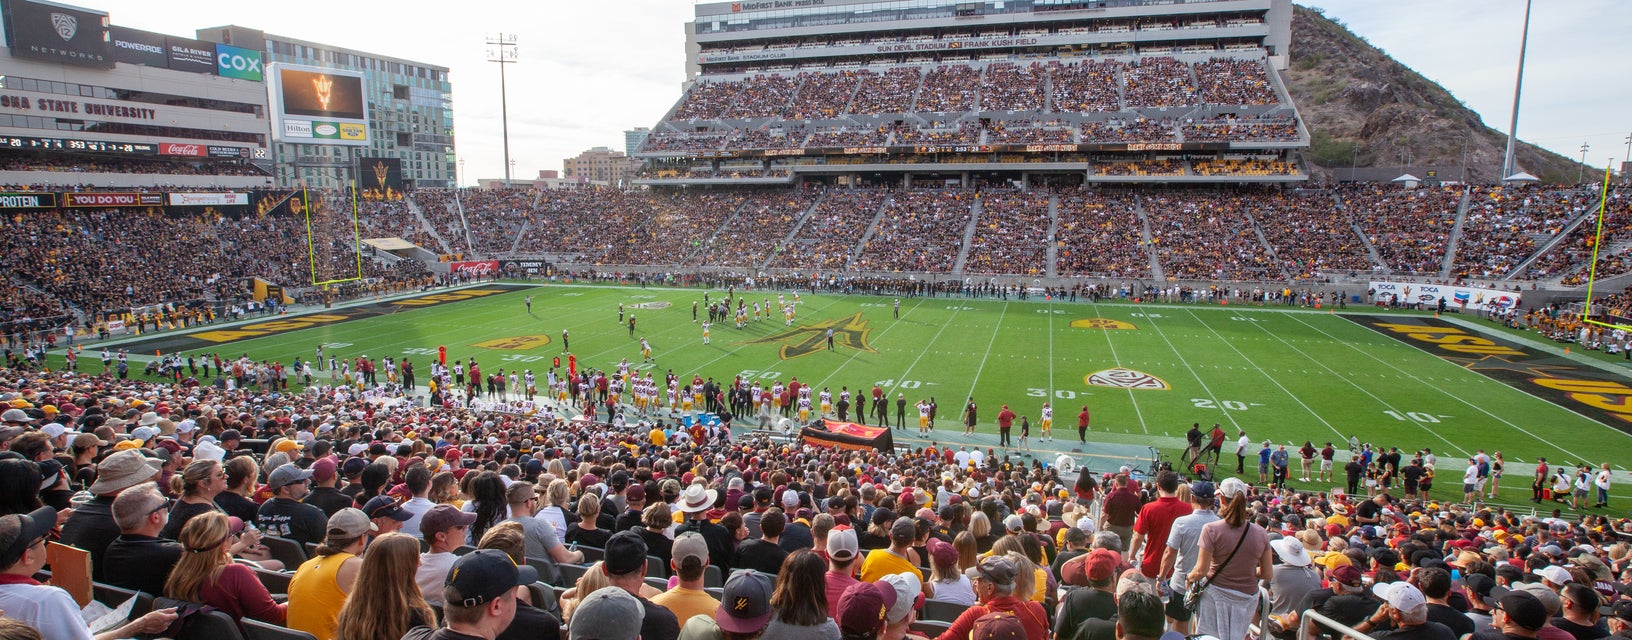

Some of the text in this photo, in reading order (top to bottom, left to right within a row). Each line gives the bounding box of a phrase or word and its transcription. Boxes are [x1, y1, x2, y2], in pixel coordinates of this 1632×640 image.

[774, 0, 793, 8] BANK
[114, 40, 163, 55] POWERADE
[916, 43, 946, 51] STADIUM
[964, 41, 989, 49] FRANK
[992, 39, 1013, 47] KUSH
[31, 45, 103, 61] NETWORKS
[172, 46, 213, 58] GILA RIVER
[218, 53, 260, 73] COX
[38, 98, 78, 113] STATE
[84, 102, 155, 120] UNIVERSITY
[168, 144, 198, 156] Coca-Cola
[74, 196, 96, 204] YOU
[98, 196, 113, 204] DO
[114, 195, 134, 204] YOU
[1026, 388, 1076, 399] 30
[1190, 398, 1249, 411] 20
[1383, 410, 1441, 423] 10
